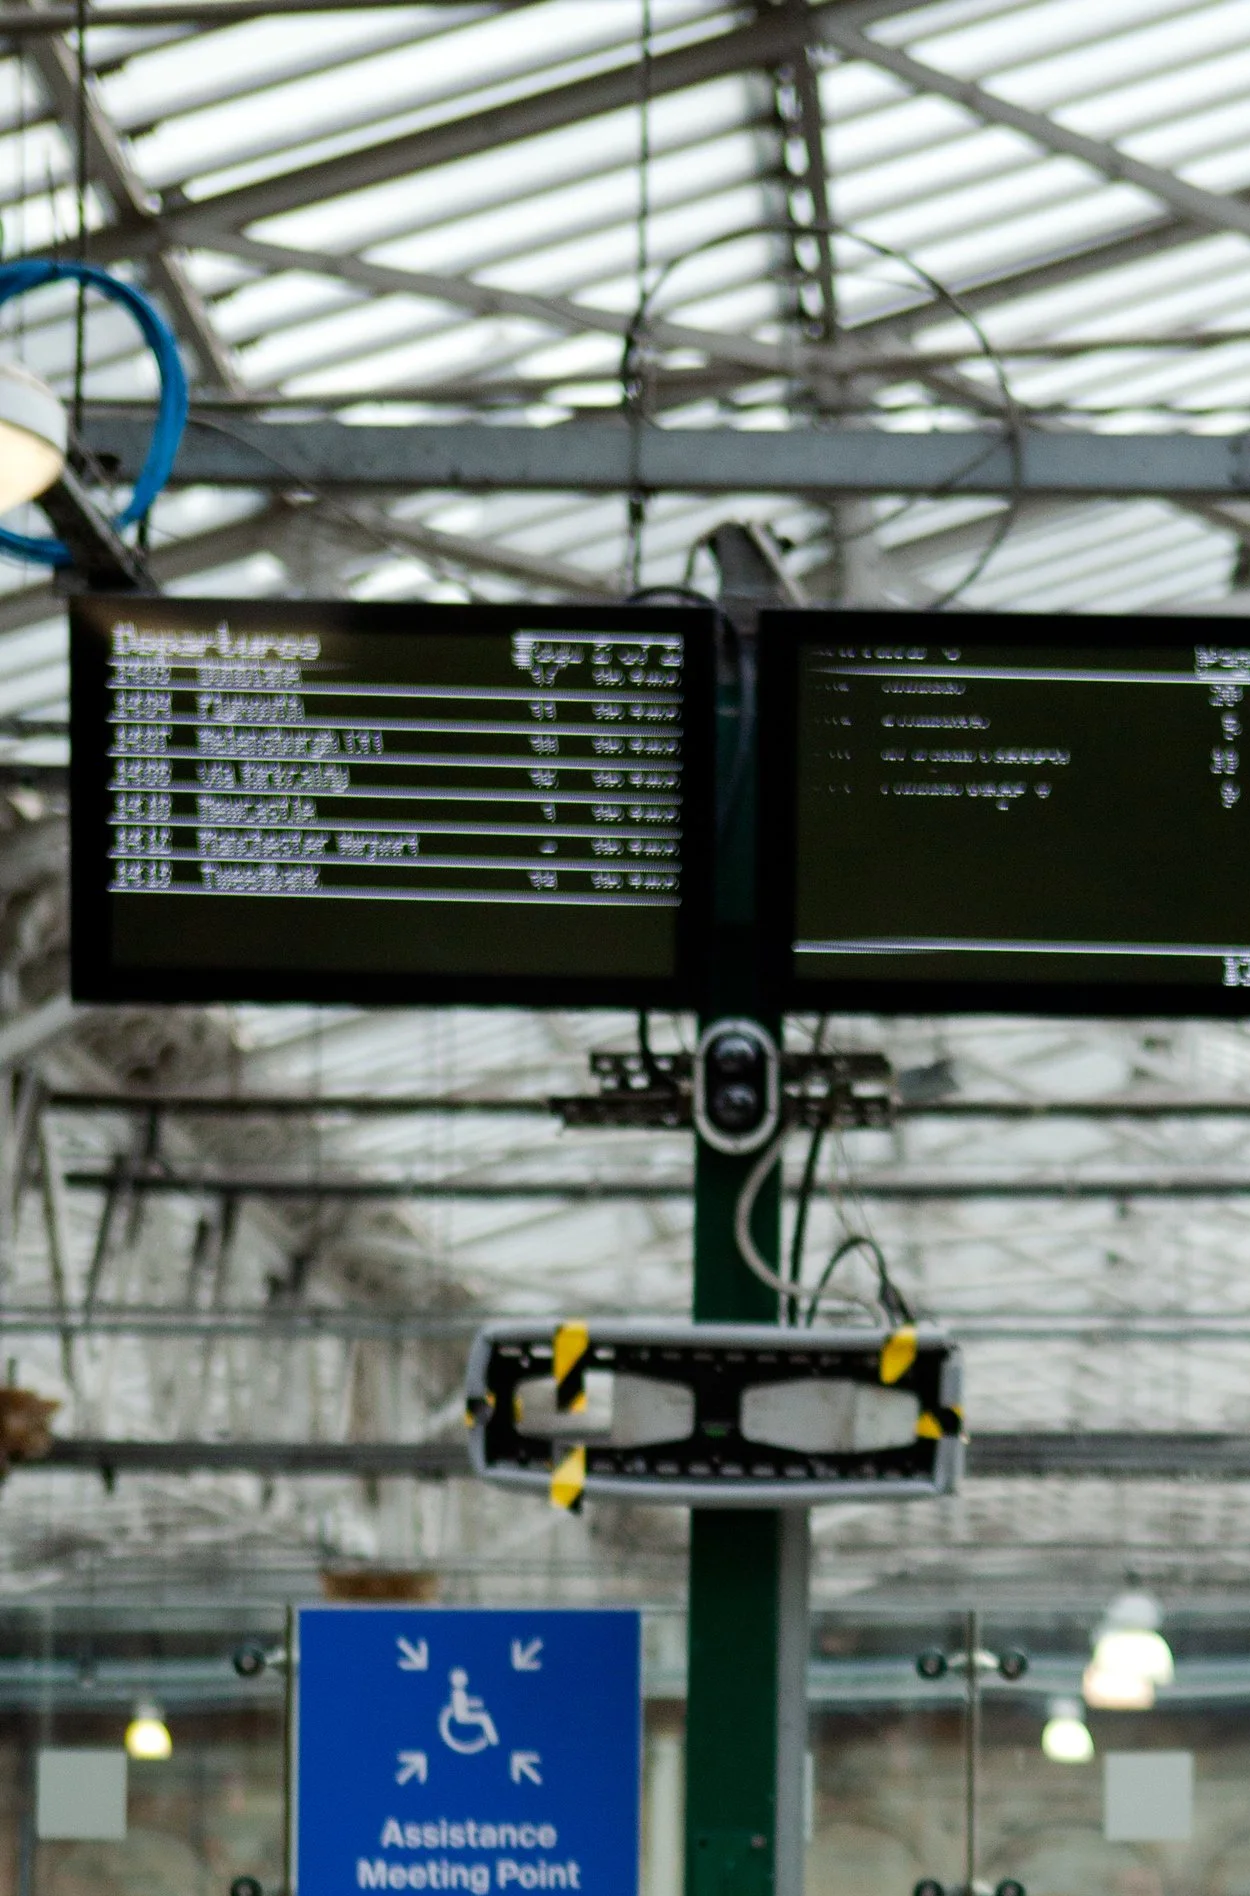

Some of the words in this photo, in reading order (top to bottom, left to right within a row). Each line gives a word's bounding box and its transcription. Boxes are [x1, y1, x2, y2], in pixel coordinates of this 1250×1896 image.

[381, 1816, 557, 1849] Assistance
[357, 1858, 489, 1896] Meeting
[496, 1859, 580, 1889] Point
